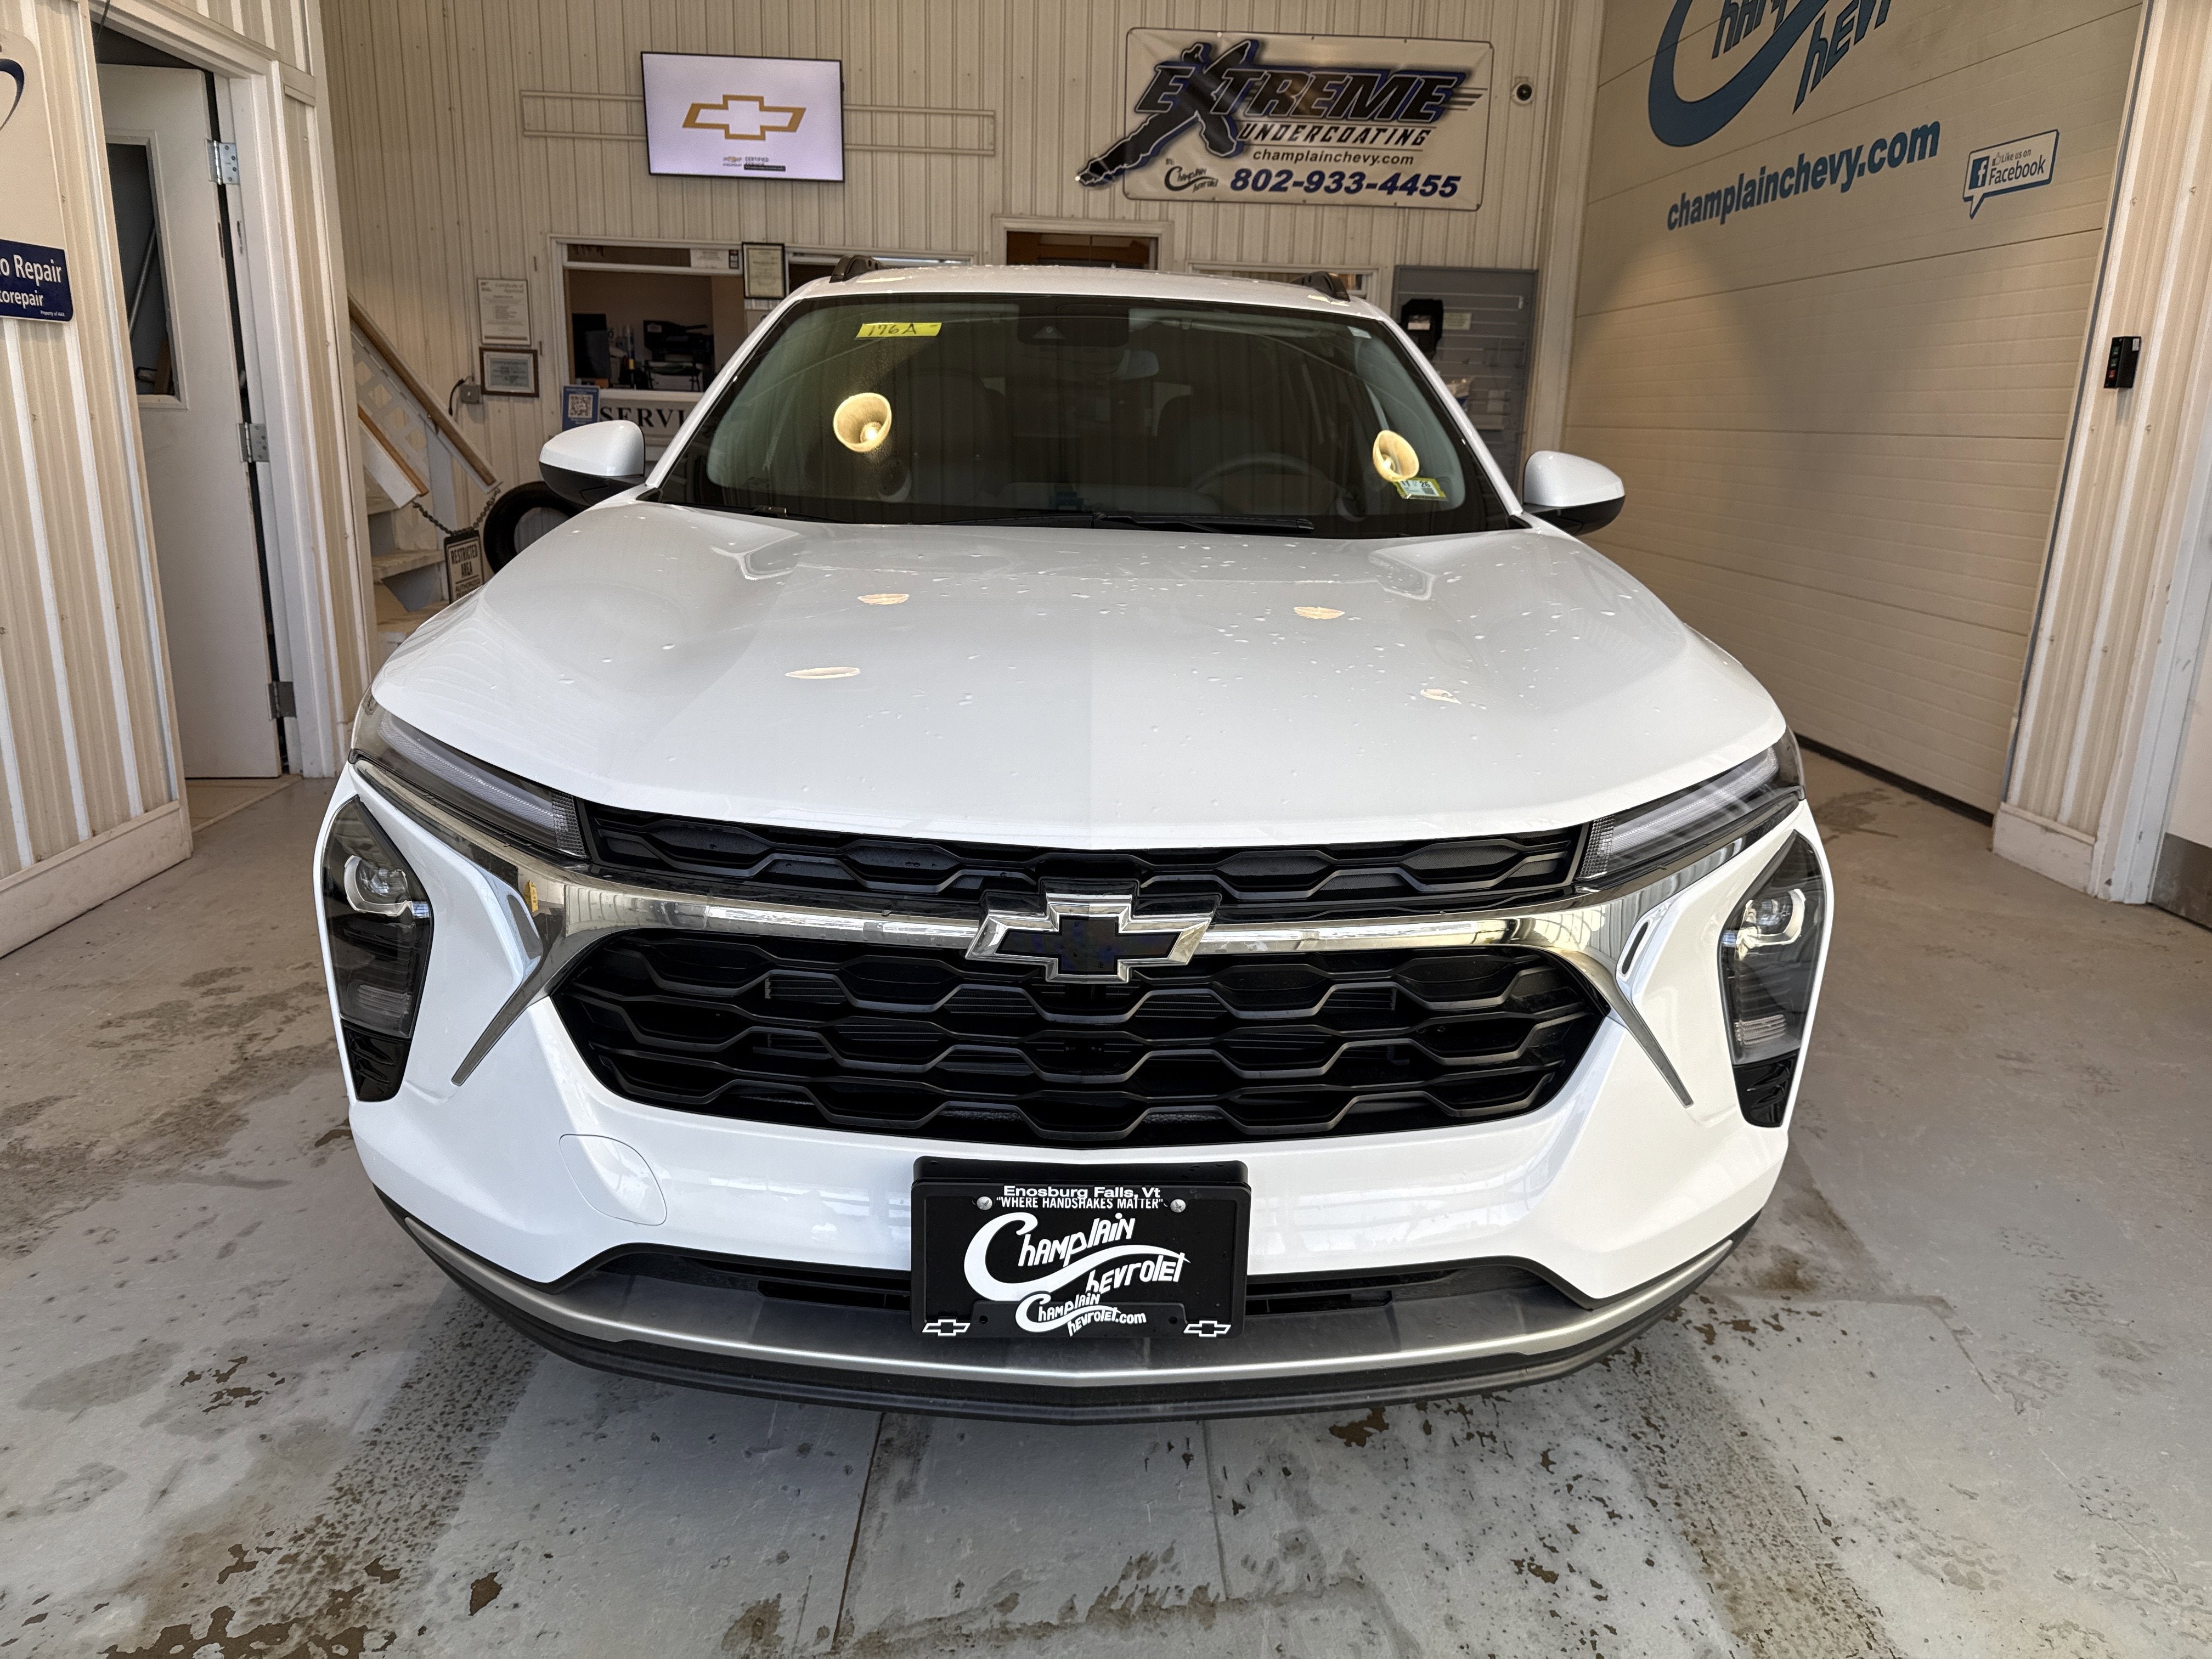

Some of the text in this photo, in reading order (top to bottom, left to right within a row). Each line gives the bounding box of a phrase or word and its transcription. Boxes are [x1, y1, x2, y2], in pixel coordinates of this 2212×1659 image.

[1237, 122, 1432, 147] UNDERCOATING
[1252, 149, 1415, 166] champlainchevy.com
[2001, 149, 2032, 163] Like us on
[1230, 168, 1462, 198] 802-933-4455
[1666, 120, 1941, 231] champlainchevy.com
[1988, 155, 2046, 186] Facebook
[13, 254, 62, 286] Repair
[1003, 1185, 1161, 1200] Enosburg Falls, Vt
[1042, 1198, 1114, 1209] HANDSHAKES
